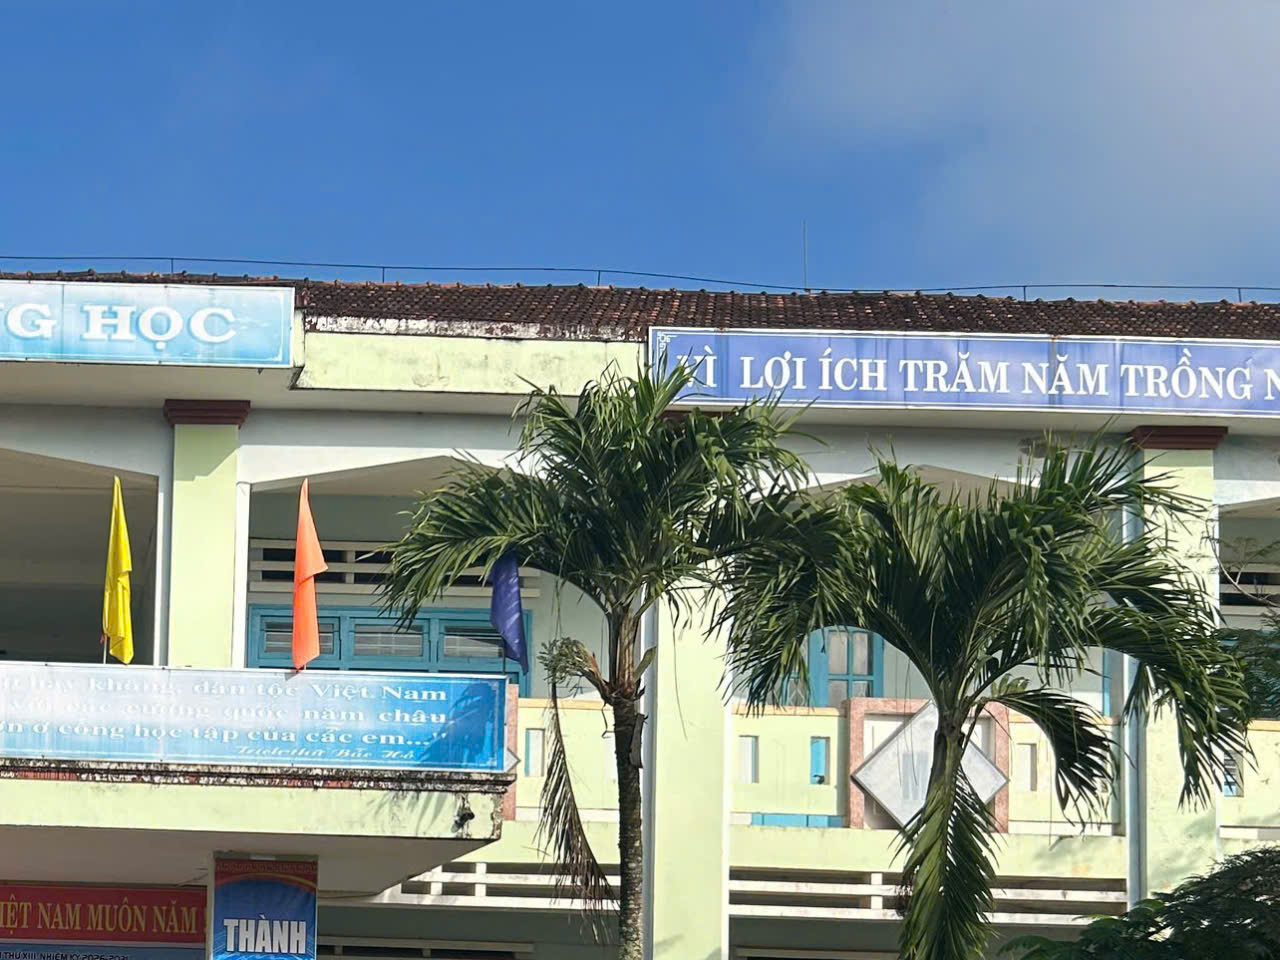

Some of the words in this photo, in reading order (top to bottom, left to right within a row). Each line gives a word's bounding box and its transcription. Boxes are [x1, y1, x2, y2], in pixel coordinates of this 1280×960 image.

[82, 304, 237, 354] HỌC
[740, 352, 806, 398] LỢI
[818, 347, 888, 393] ÍCH
[899, 352, 1010, 394] TRĂM
[1022, 354, 1109, 397] NĂM
[1121, 348, 1254, 401] TRỒNG
[257, 683, 298, 698] tộc
[310, 684, 370, 700] Việt
[382, 686, 447, 701] Nam
[58, 720, 124, 739] công
[135, 723, 182, 740] học
[192, 726, 239, 742] tập
[247, 727, 295, 742] của
[305, 727, 352, 744] các
[37, 902, 81, 931] NAM
[87, 897, 148, 933] MUÔN
[152, 900, 198, 934] NĂM
[223, 914, 306, 954] THÀNH
